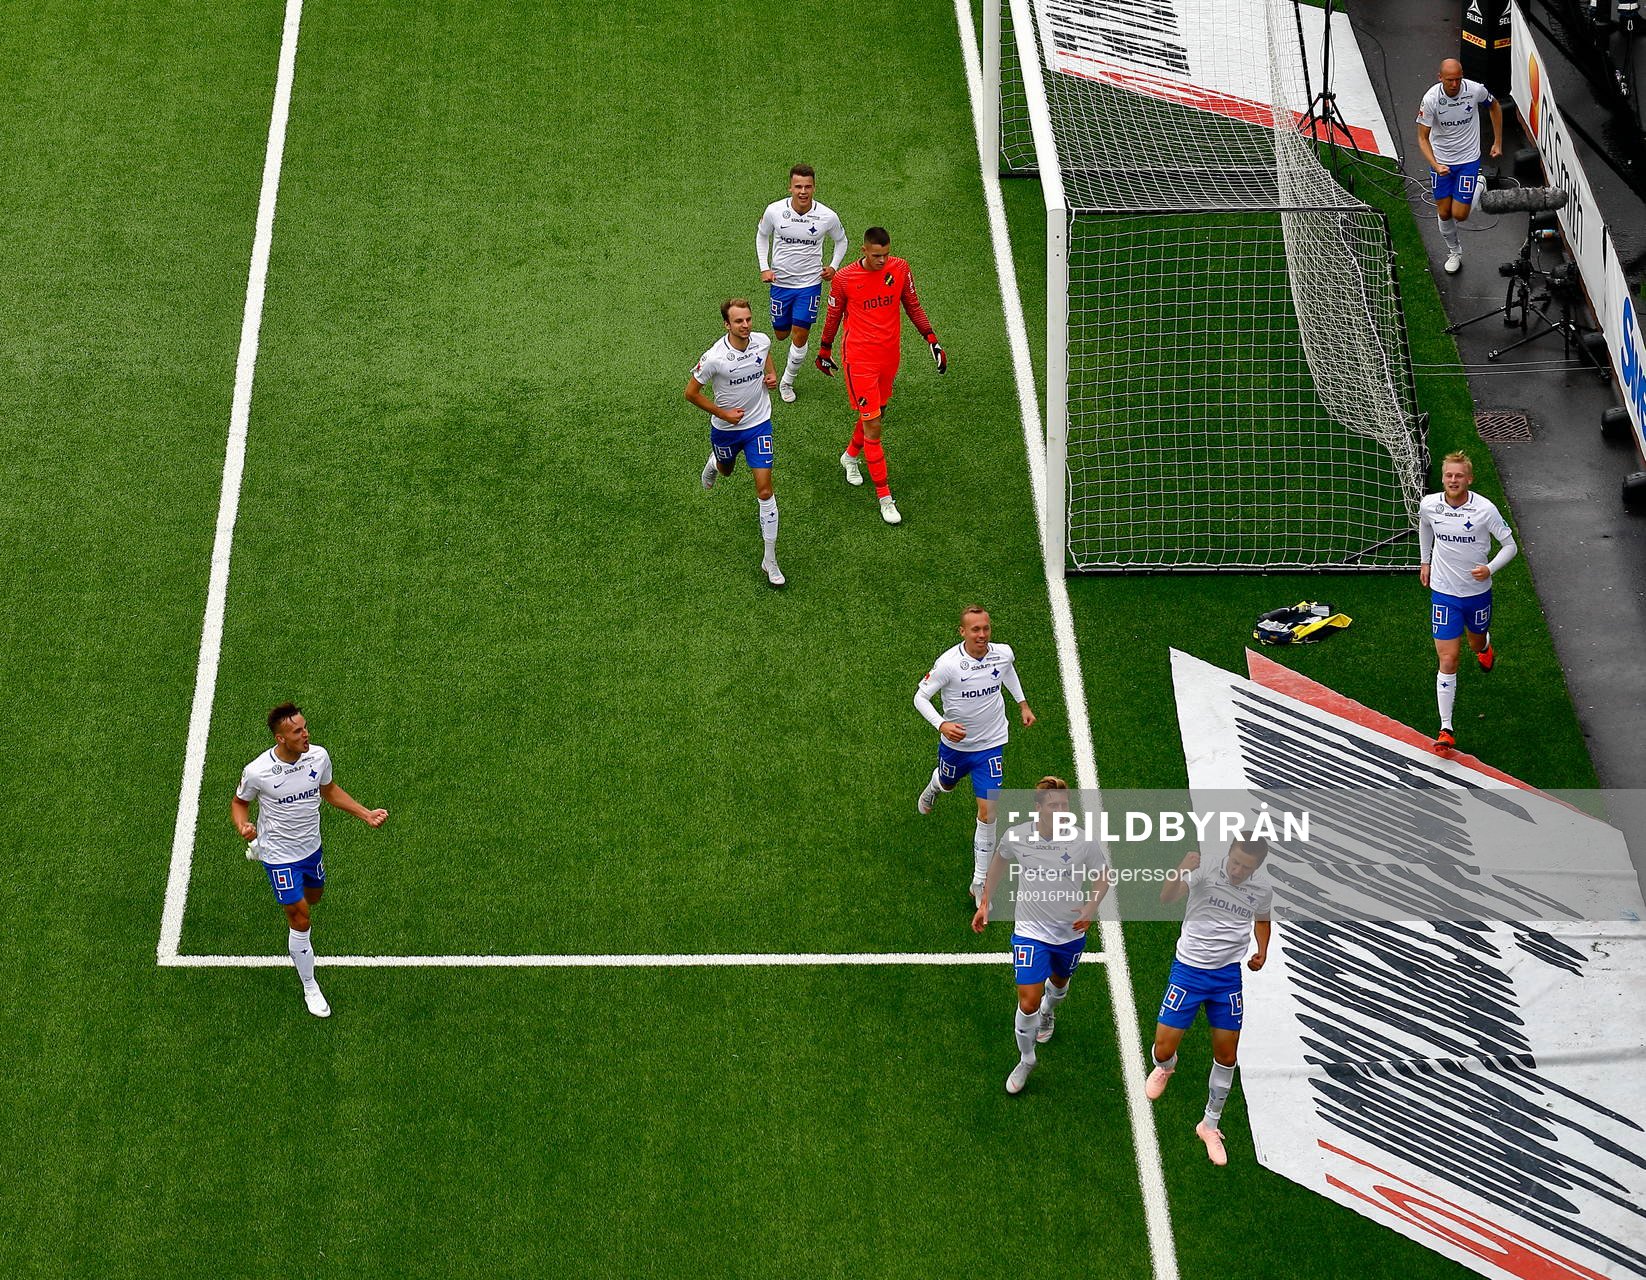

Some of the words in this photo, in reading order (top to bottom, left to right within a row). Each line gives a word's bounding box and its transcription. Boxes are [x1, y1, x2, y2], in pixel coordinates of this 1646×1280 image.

[1466, 12, 1483, 25] SELECT
[1555, 132, 1583, 256] Smith
[863, 294, 894, 312] notar
[1435, 532, 1476, 544] HOLMEN
[961, 684, 1000, 698] HOLMEN
[1208, 895, 1254, 919] HOLMEN
